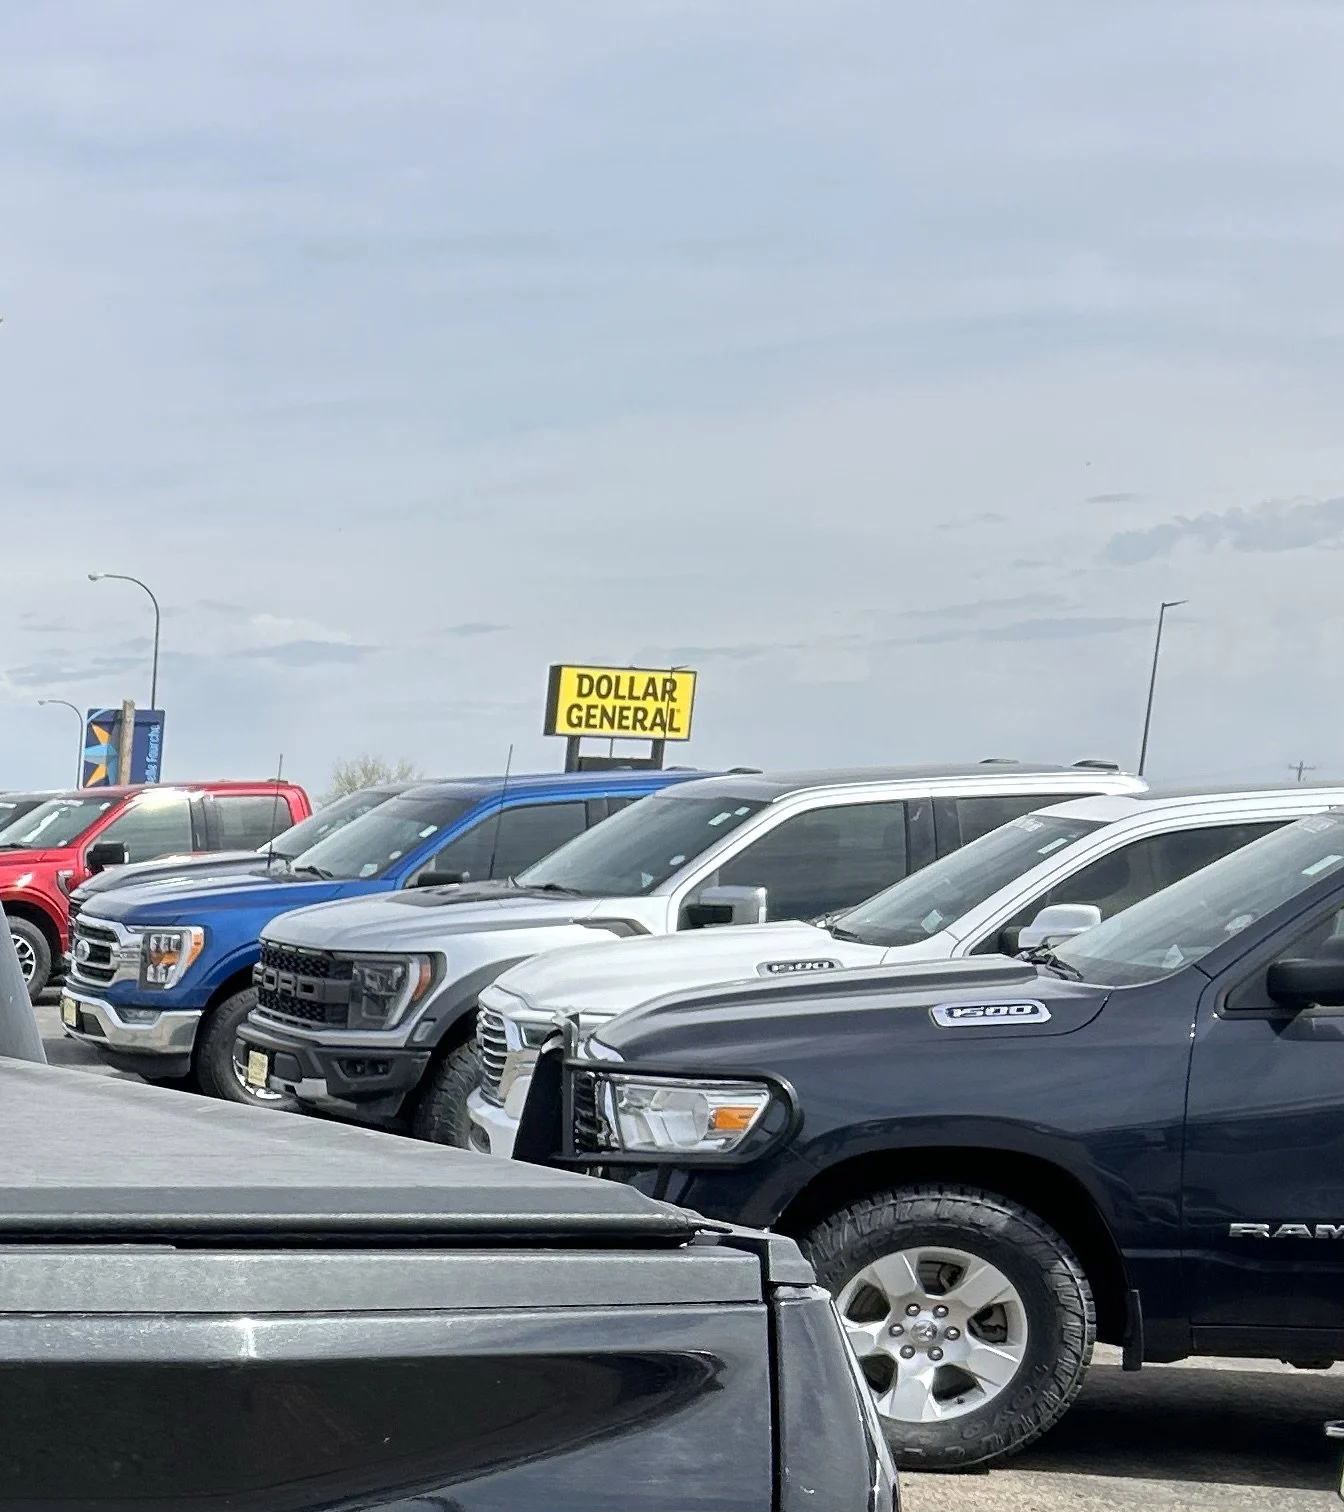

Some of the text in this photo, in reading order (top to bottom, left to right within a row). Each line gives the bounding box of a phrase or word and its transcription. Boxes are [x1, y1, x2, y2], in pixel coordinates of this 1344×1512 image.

[576, 673, 678, 703] DOLLAR
[565, 703, 681, 733] GENERAL
[949, 1004, 1034, 1018] 1500
[1228, 1223, 1344, 1239] RAM
